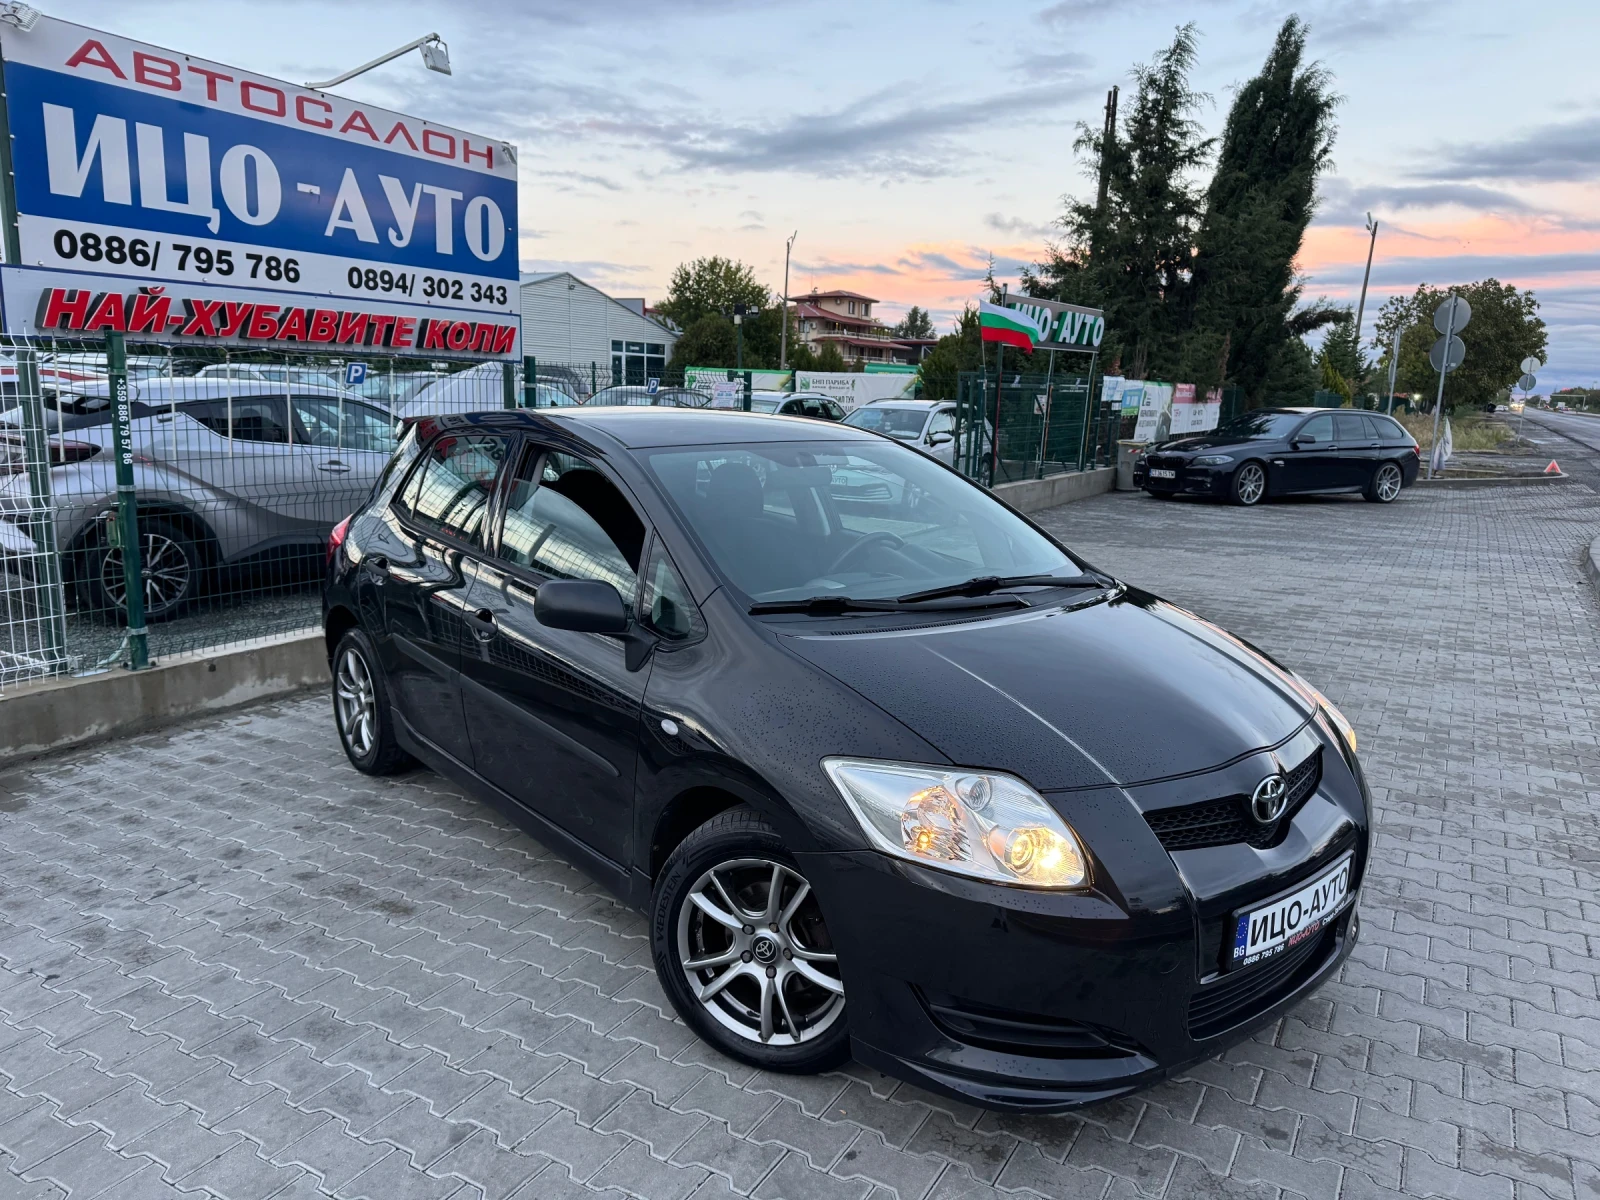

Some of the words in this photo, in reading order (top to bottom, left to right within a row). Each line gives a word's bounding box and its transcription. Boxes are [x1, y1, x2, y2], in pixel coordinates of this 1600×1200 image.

[65, 39, 493, 169] АВТОСАЛОН
[53, 229, 161, 271] 0886/
[172, 243, 235, 276] 795
[245, 252, 301, 283] 786
[347, 266, 416, 297] 0894/
[422, 276, 464, 300] 302
[470, 282, 507, 305] 343
[40, 286, 417, 348] НАЙ-ХУБАВИТЕ
[421, 318, 517, 353] КОЛИ
[117, 378, 127, 402] +359
[117, 404, 129, 422] 886
[119, 424, 130, 436] 79
[121, 439, 132, 450] 57
[122, 452, 134, 465] 86
[656, 871, 682, 942] VREDESTEIN
[1250, 866, 1348, 947] ИЦО-АУТО
[1233, 945, 1245, 958] BG
[1261, 947, 1273, 959] 795
